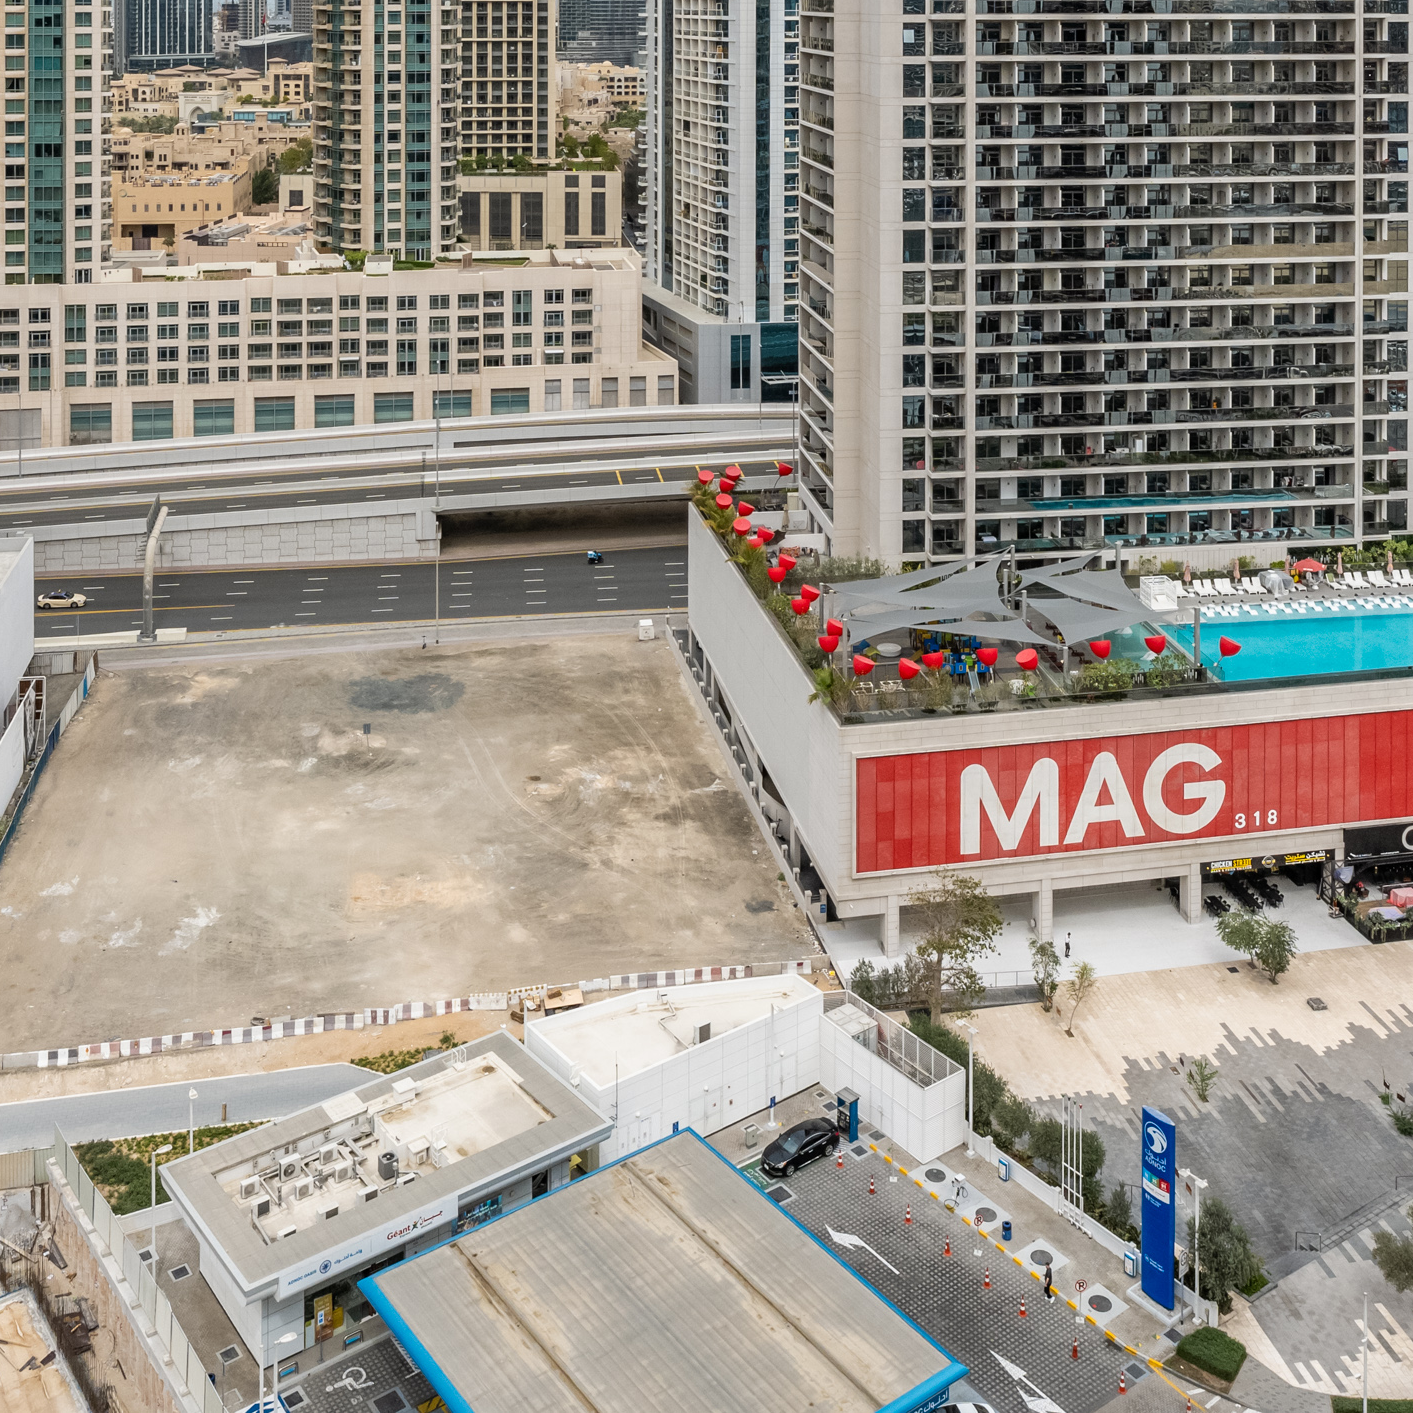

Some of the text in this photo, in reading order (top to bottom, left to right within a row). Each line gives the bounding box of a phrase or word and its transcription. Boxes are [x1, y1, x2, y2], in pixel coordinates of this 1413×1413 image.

[960, 742, 1279, 856] MAG 318
[1210, 860, 1233, 870] CHICKEN
[1144, 1155, 1167, 1173] ADNOC
[386, 1224, 411, 1241] Géant
[287, 1274, 304, 1286] ADNOC
